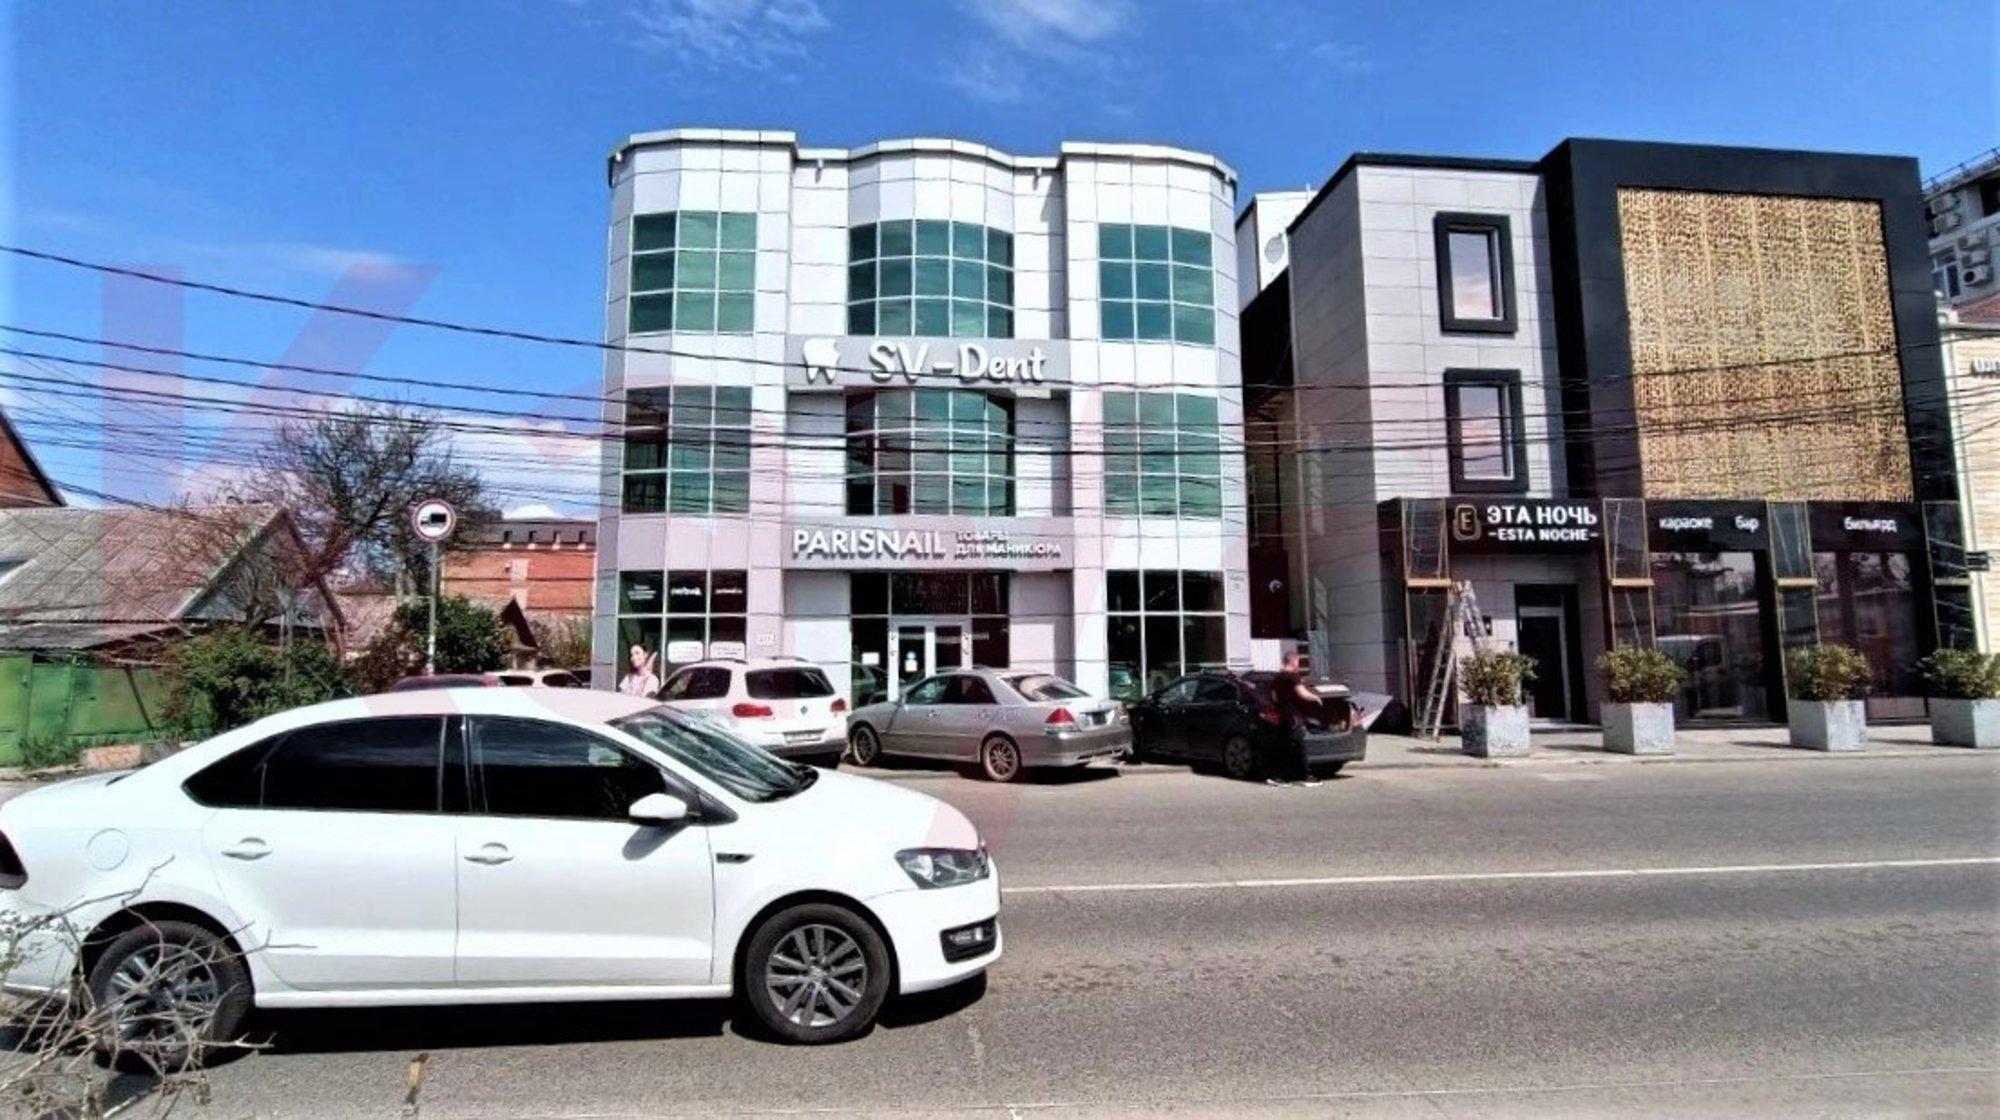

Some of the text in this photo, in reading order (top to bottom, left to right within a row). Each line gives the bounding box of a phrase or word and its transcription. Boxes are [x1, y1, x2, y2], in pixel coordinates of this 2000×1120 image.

[869, 338, 1047, 382] SV-Dent
[1486, 505, 1598, 525] ЭТА НОЧЬ
[1659, 514, 1760, 533] караоке бар
[1843, 516, 1898, 533] бильярд
[793, 530, 945, 558] PARISNAIL
[984, 544, 1062, 558] МАНИКЮРА
